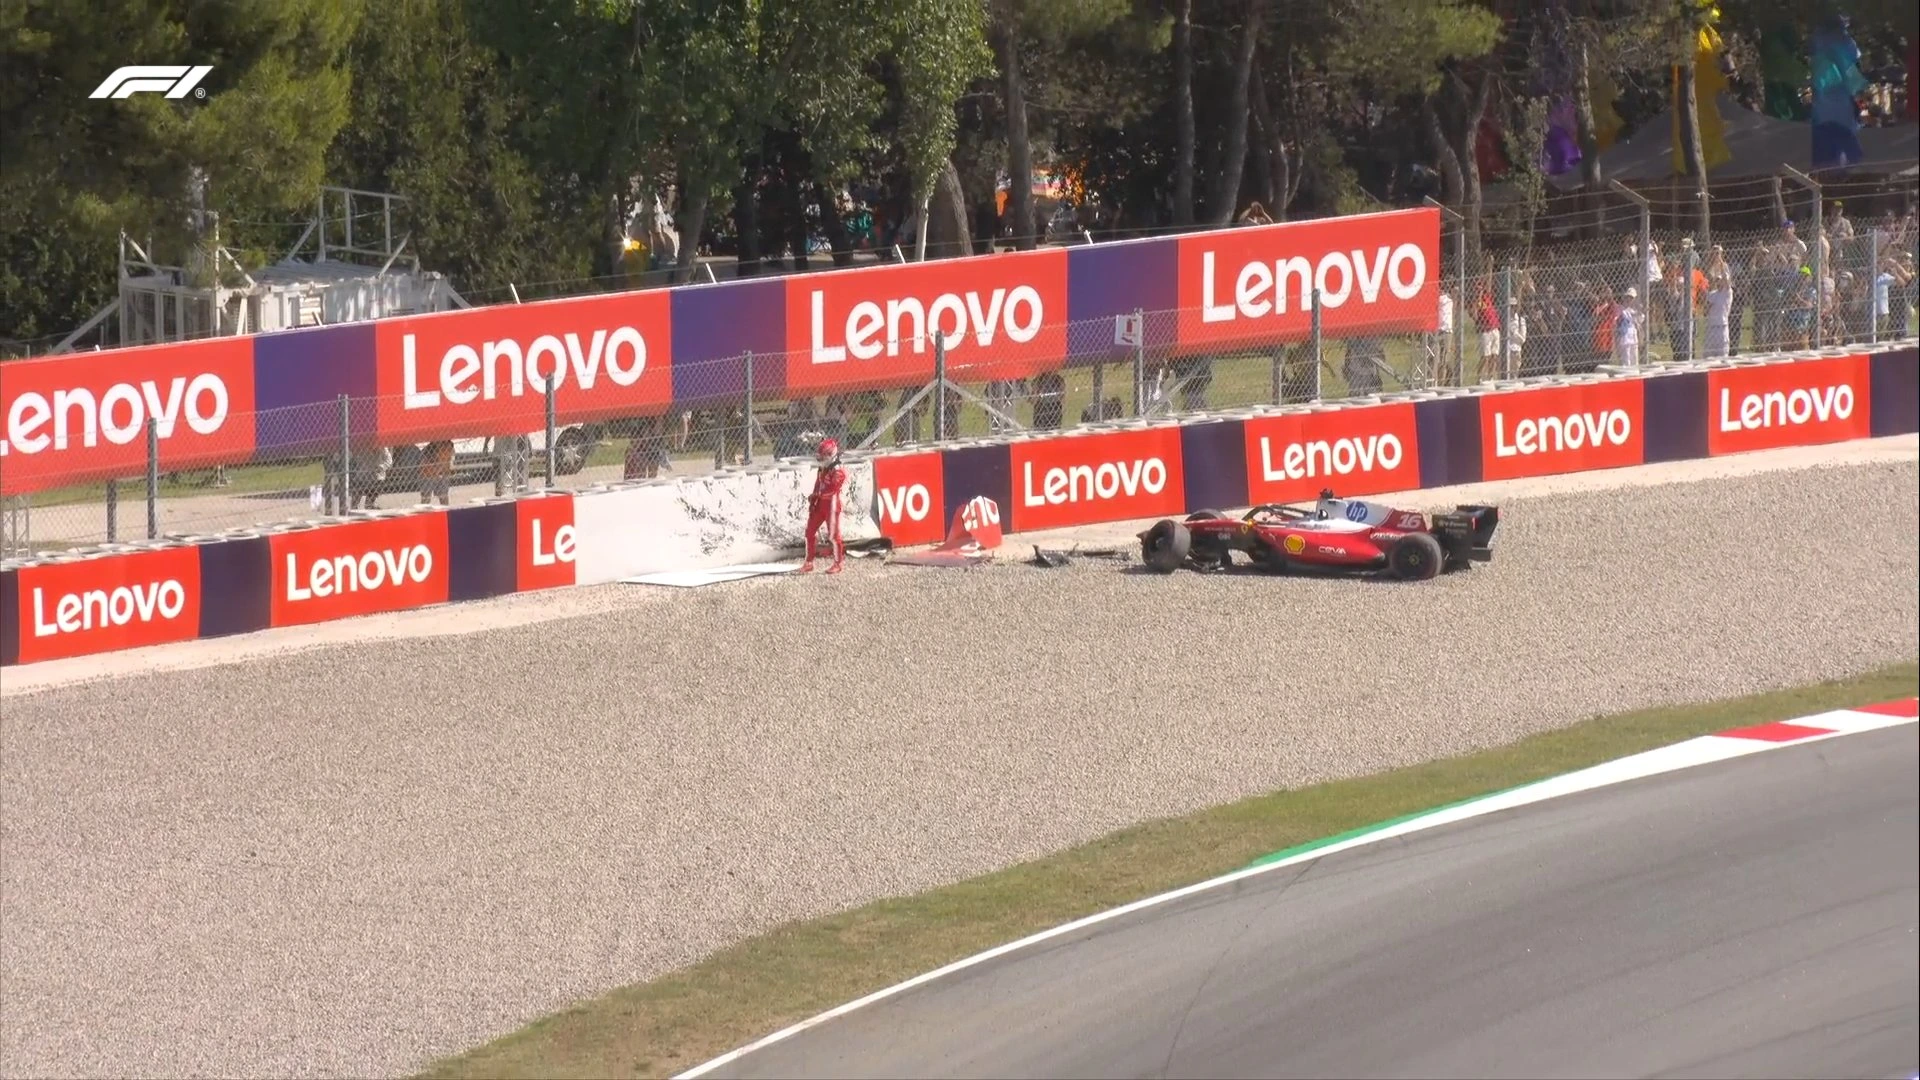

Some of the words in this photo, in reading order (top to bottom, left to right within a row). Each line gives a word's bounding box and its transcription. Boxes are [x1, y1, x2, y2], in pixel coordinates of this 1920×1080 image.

[1202, 243, 1426, 323] Lenovo
[811, 285, 1044, 365] Lenovo
[403, 326, 647, 410] Lenovo
[0, 373, 229, 457] enovo
[1494, 408, 1631, 457] Lenovo
[1720, 384, 1854, 432] Lenovo
[1024, 457, 1167, 507] Lenovo
[1260, 433, 1403, 482] Lenovo
[877, 483, 931, 524] vo
[1347, 500, 1366, 522] hp
[1397, 513, 1421, 529] 16
[533, 518, 576, 566] Le
[286, 544, 433, 601] Lenovo
[33, 579, 185, 637] Lenovo
